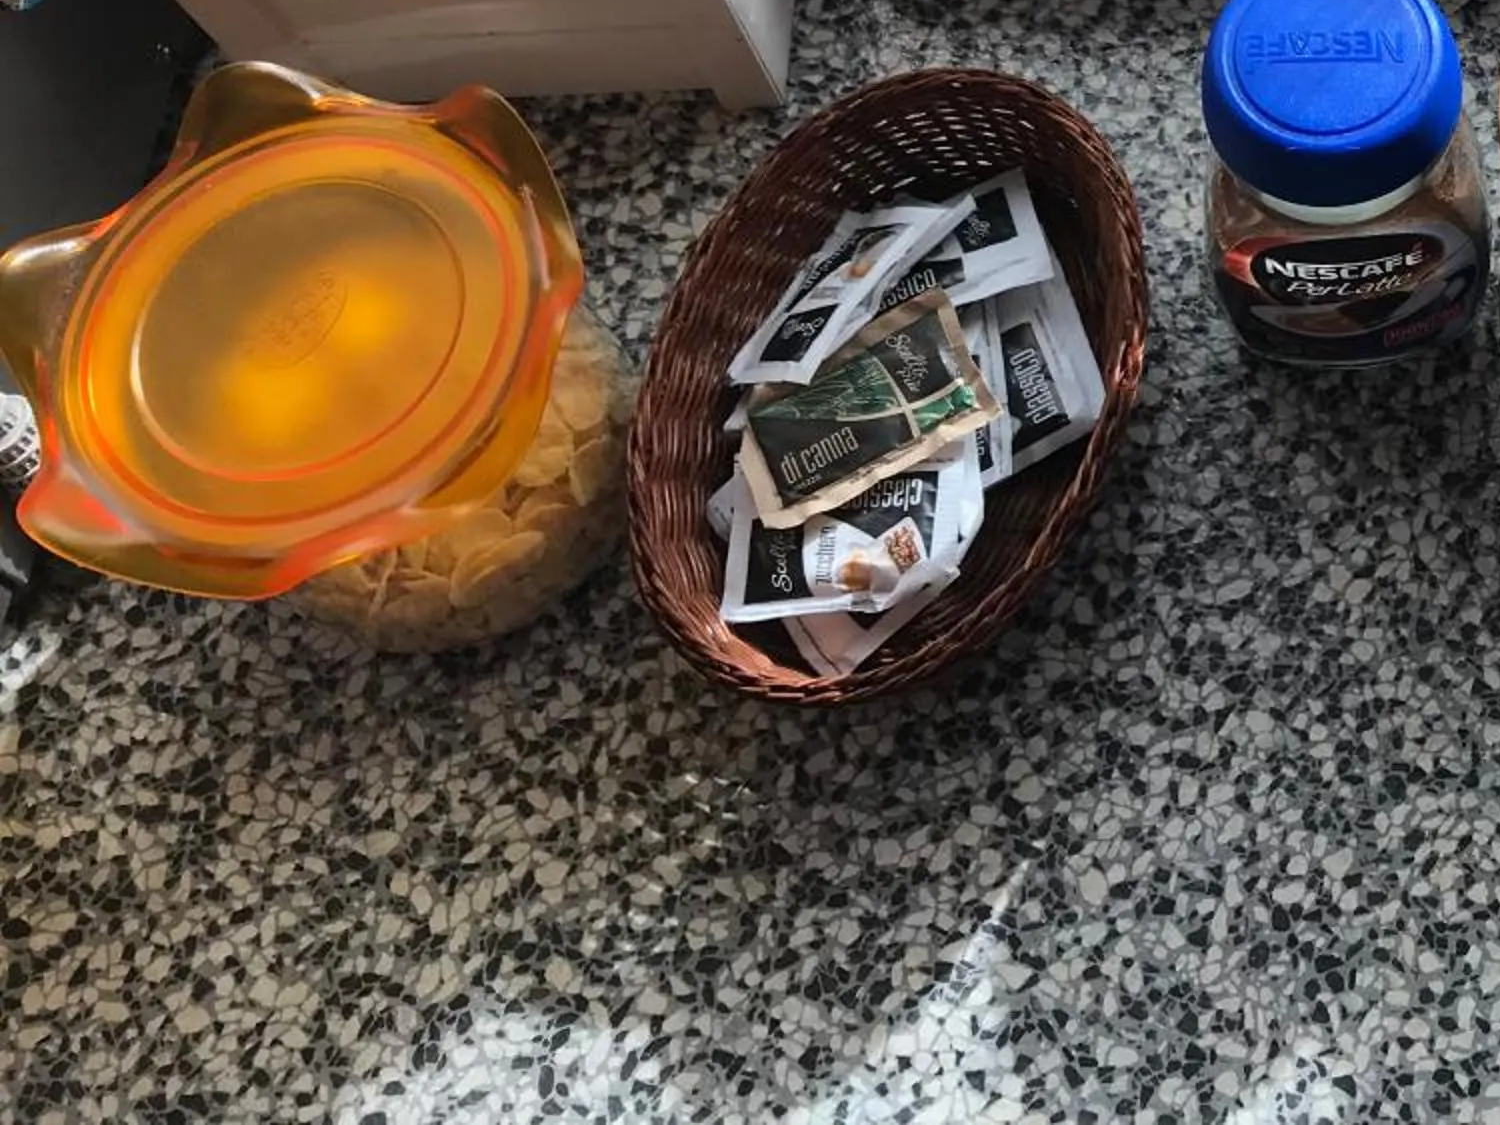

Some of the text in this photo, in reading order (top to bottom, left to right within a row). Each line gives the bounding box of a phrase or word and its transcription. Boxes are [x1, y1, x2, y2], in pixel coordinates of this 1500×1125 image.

[1264, 241, 1424, 280] NESCAFÉ
[780, 451, 801, 485] di
[802, 426, 860, 473] canna
[841, 478, 923, 512] classic
